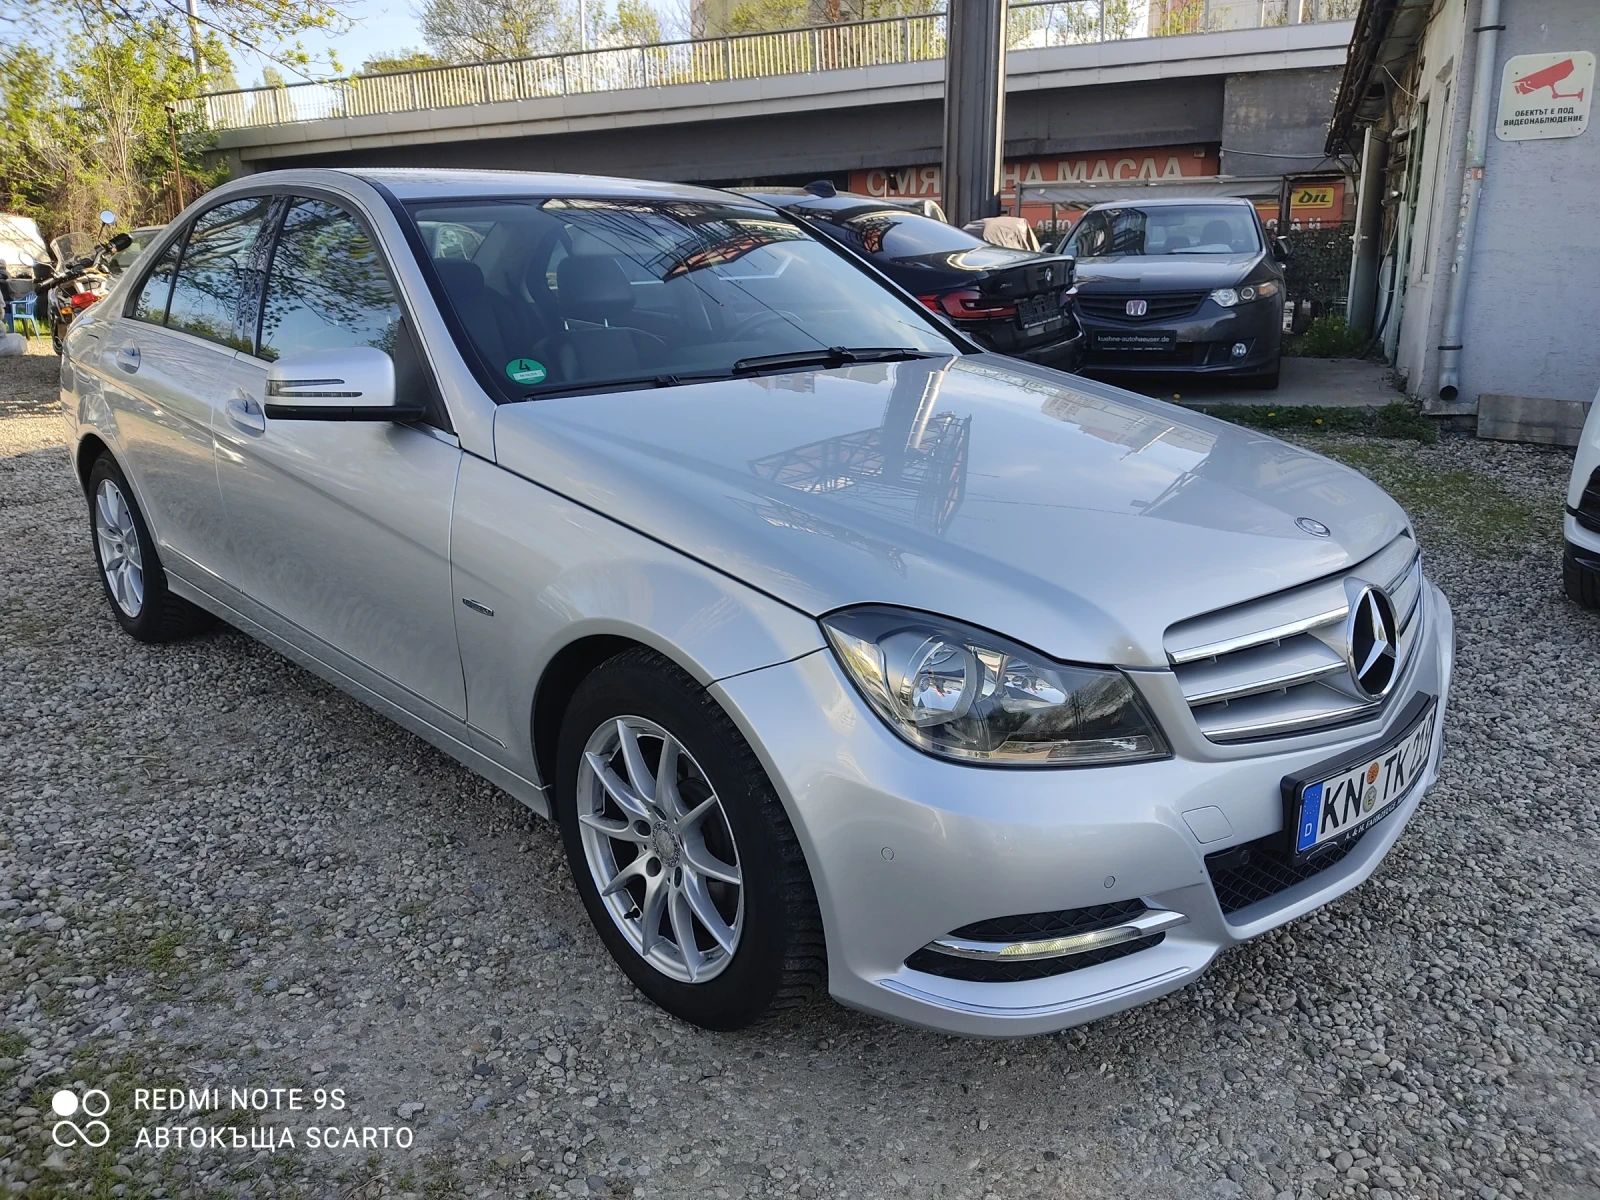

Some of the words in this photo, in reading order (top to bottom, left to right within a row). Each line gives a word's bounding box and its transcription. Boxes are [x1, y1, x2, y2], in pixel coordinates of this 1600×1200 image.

[1515, 108, 1548, 117] ОБЕКТЪТ
[1503, 115, 1584, 126] ВИДЕОНАБЛЮДЕНИЕ
[866, 167, 941, 197] СМЯ
[519, 360, 530, 371] 4
[1320, 772, 1365, 835] KN
[1383, 743, 1411, 801] TK
[1304, 822, 1313, 837] D
